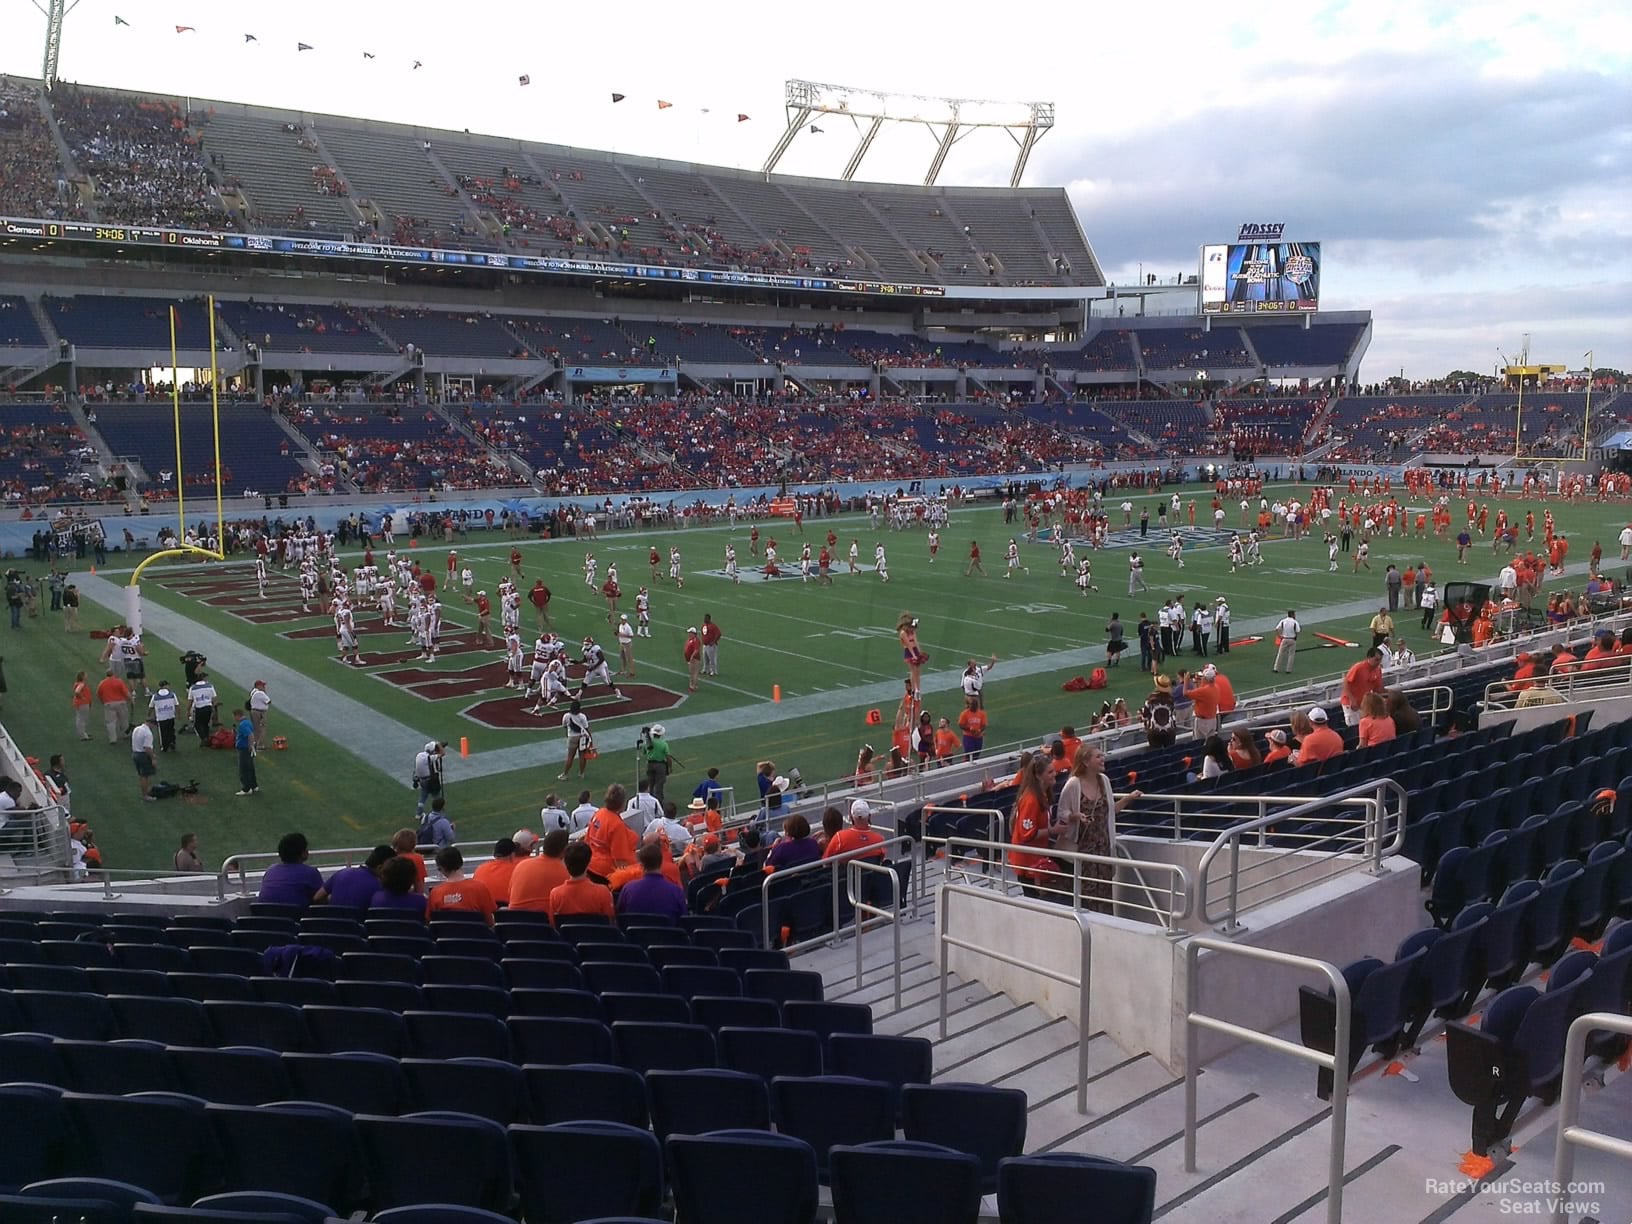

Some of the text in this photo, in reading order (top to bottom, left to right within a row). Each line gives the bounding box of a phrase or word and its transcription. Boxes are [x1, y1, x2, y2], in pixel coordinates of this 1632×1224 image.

[7, 225, 43, 235] Clemson
[49, 224, 58, 236] 0
[95, 228, 125, 240] 34:06
[1241, 223, 1285, 234] MASSEY
[169, 233, 177, 244] 0
[182, 237, 220, 246] Oklahoma
[1223, 303, 1229, 311] 0
[1289, 301, 1295, 309] 0
[871, 710, 881, 723] G
[1492, 1066, 1500, 1077] R
